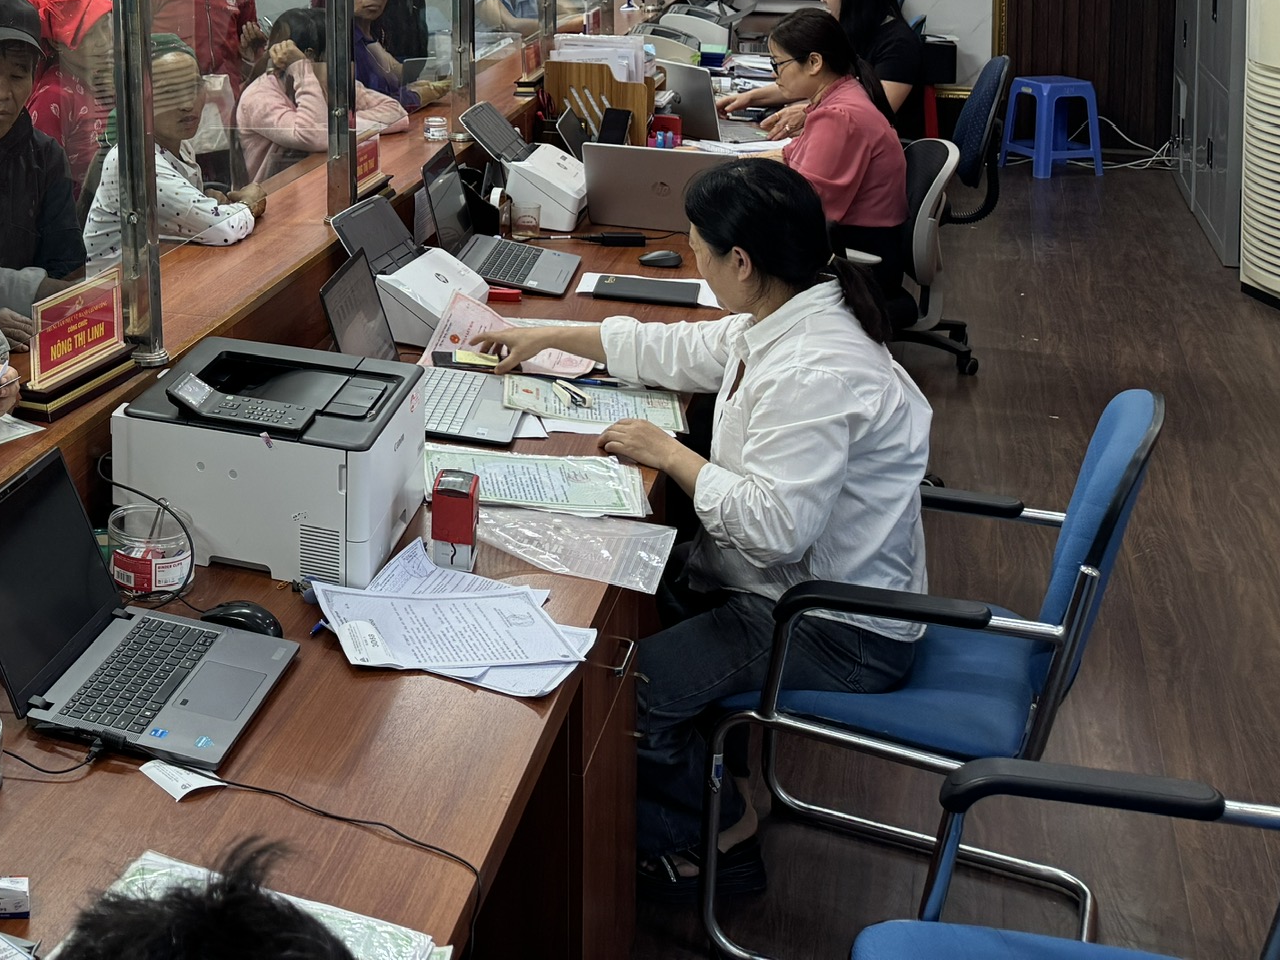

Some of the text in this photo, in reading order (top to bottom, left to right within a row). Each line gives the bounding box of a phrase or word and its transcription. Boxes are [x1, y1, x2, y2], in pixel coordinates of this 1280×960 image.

[50, 321, 105, 362] NÔNG THỊ LINH
